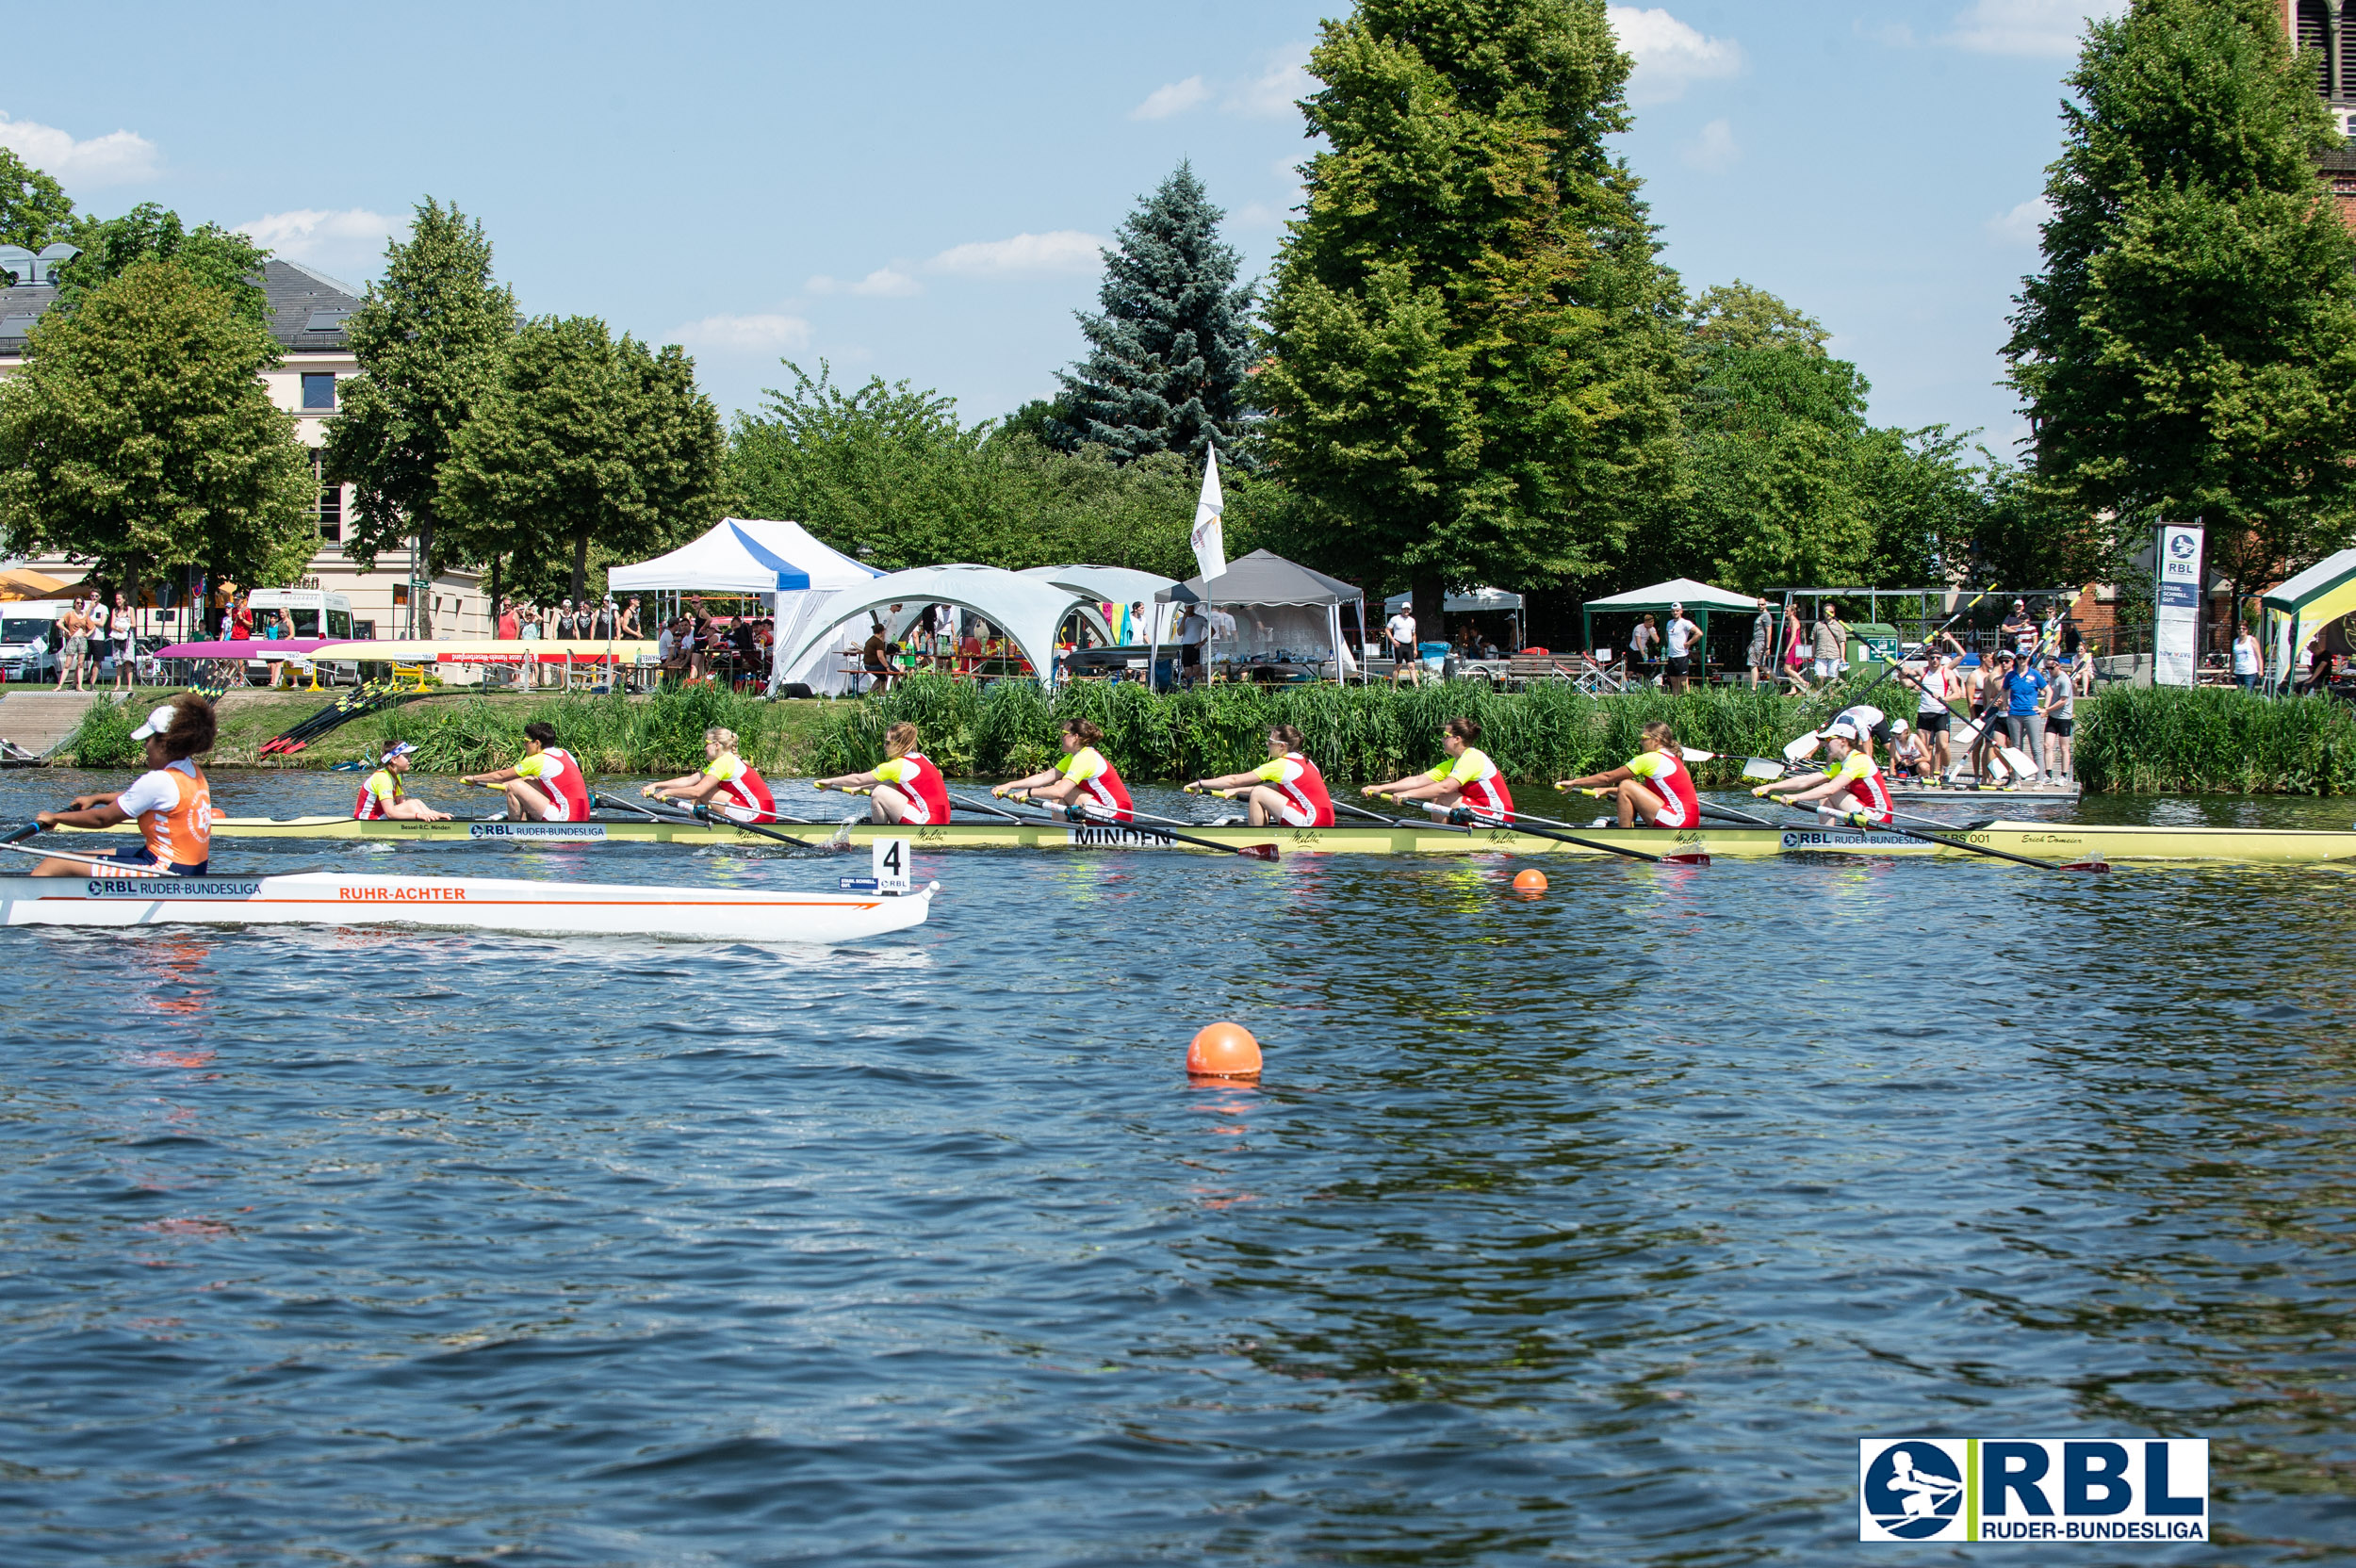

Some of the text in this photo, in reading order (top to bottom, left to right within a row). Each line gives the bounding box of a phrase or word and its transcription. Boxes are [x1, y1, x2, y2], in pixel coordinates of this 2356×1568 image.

[2168, 563, 2193, 574] RBL
[485, 825, 604, 836] RBL RUDER-BUNDESLIGA
[1800, 833, 1831, 844] RBL
[1970, 834, 1989, 843] 001
[2021, 834, 2044, 843] Erich
[883, 841, 901, 876] 4
[105, 880, 262, 894] RBL RUDER-BUNDESLIGA
[339, 887, 466, 900] RUHR-ACHTER
